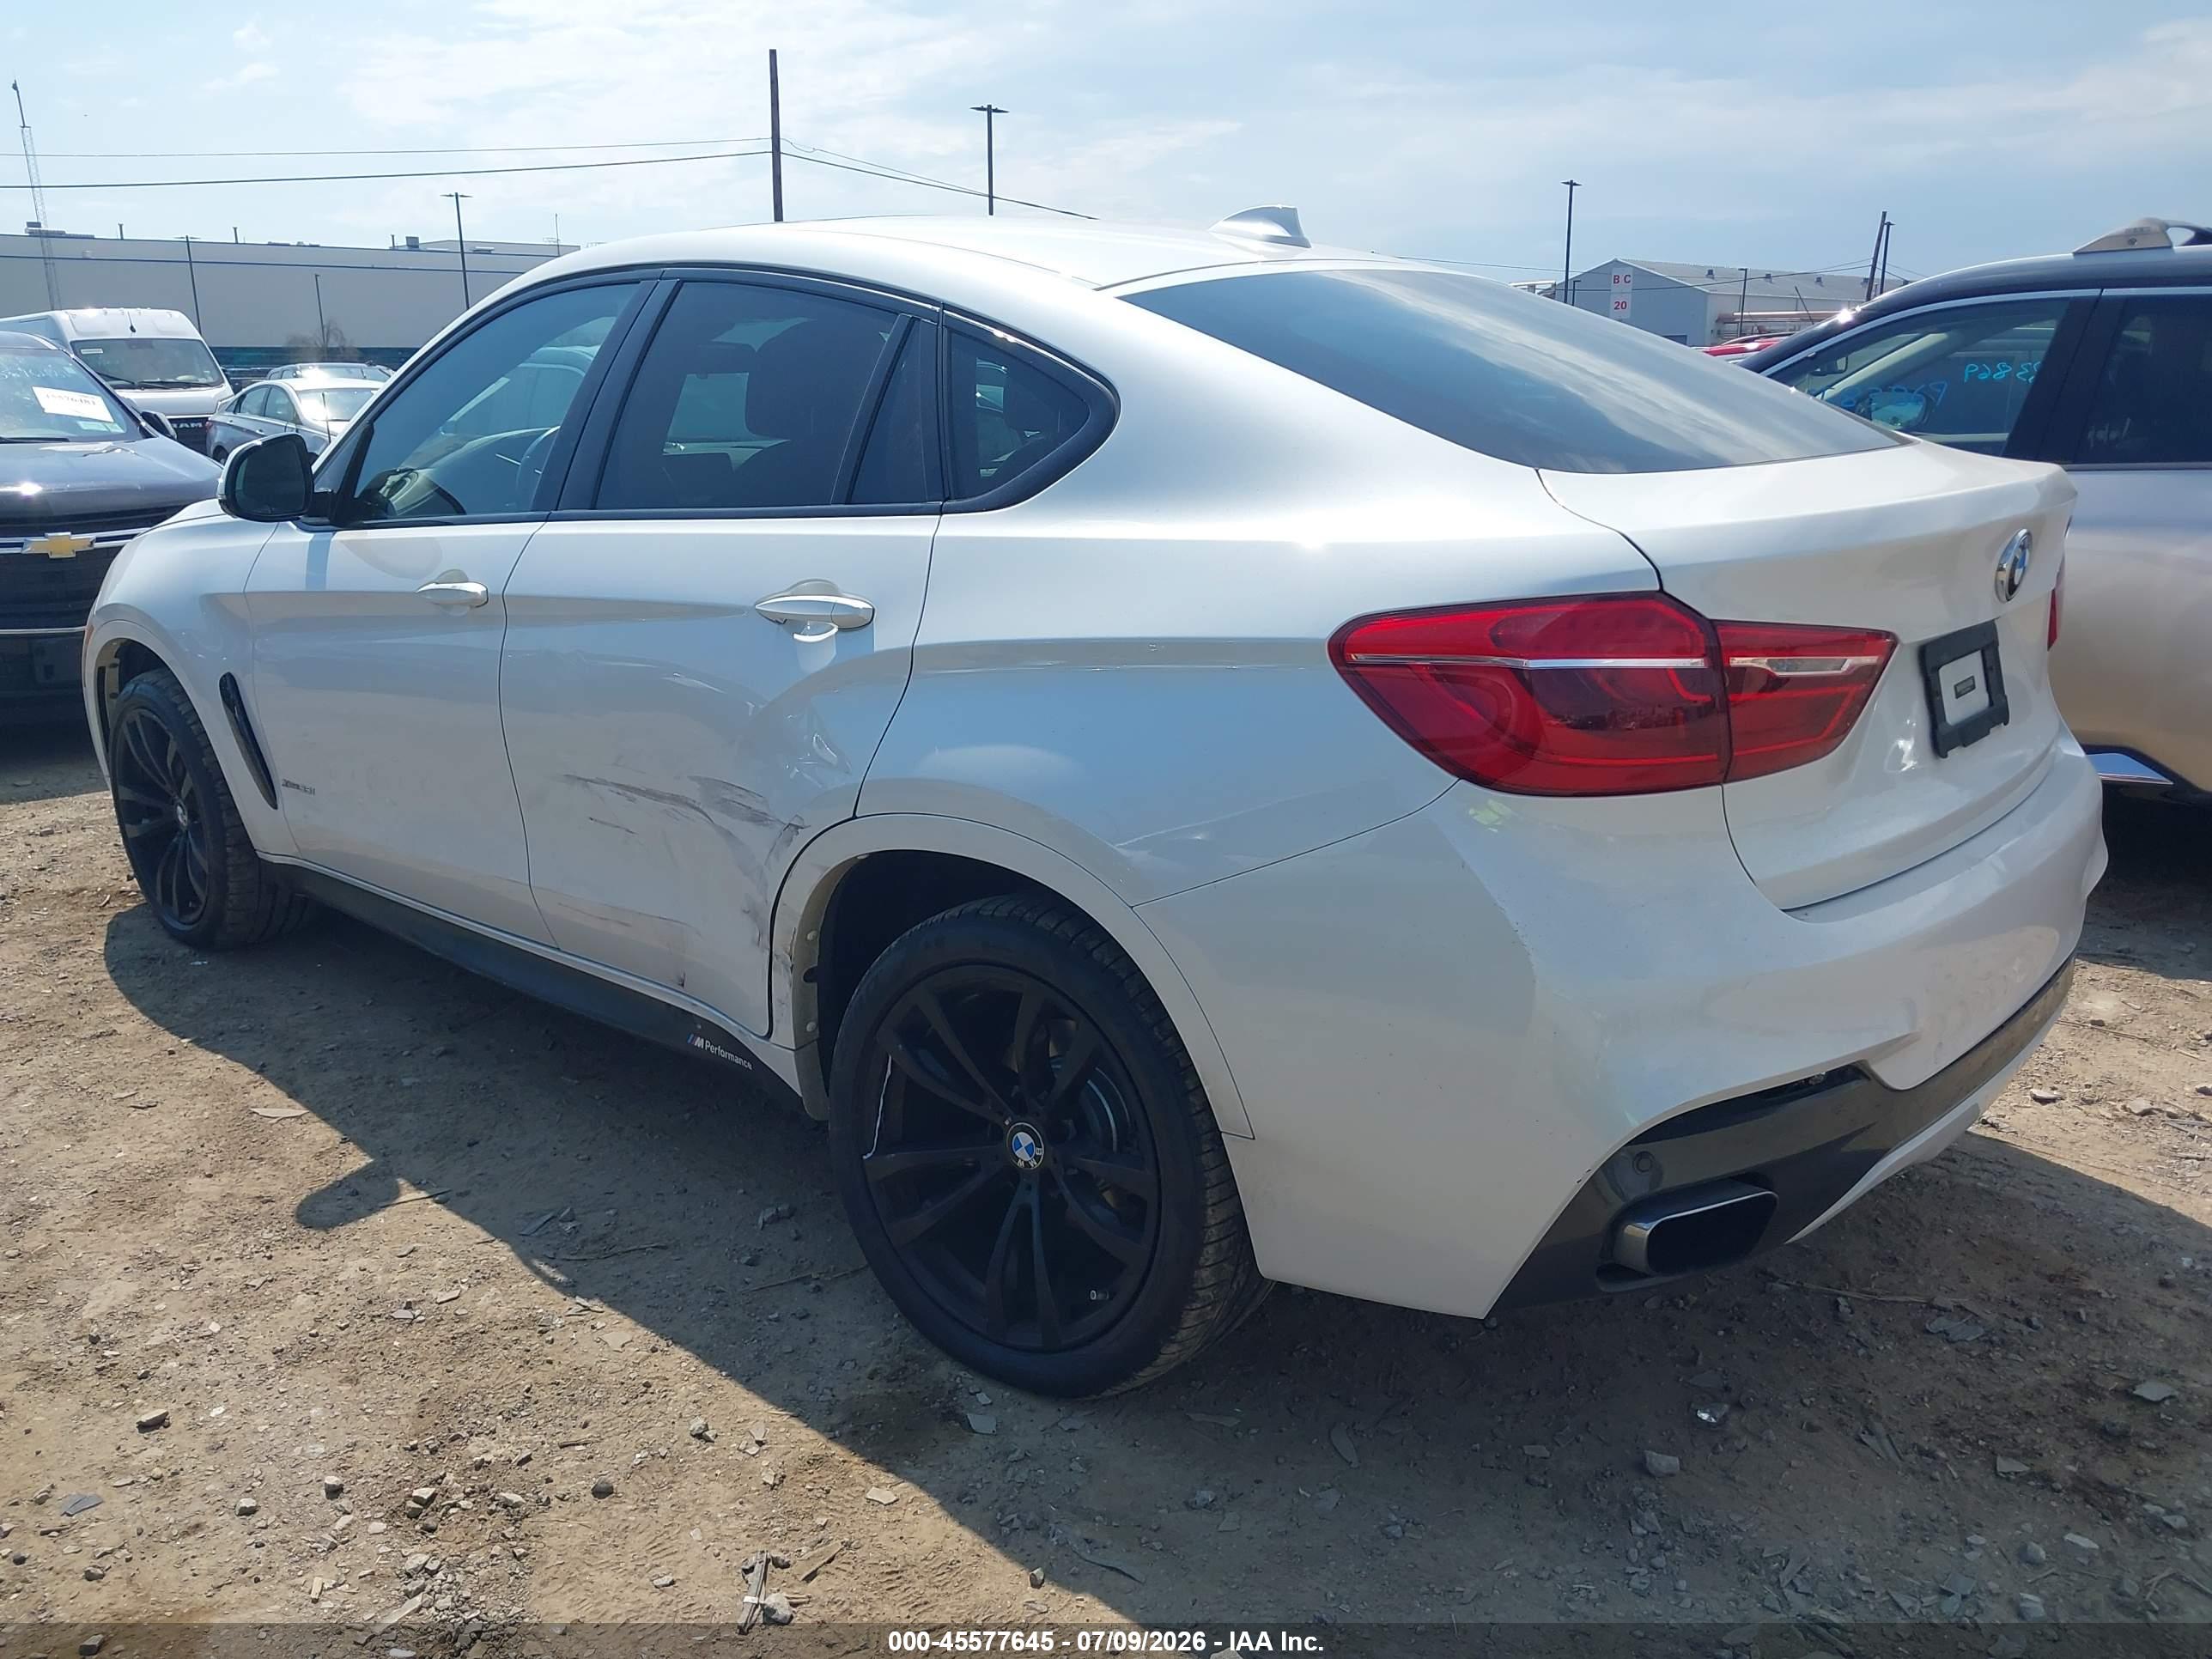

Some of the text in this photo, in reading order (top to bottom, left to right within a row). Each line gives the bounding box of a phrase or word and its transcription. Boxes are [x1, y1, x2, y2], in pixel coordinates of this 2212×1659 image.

[1613, 274, 1632, 284] B C
[1613, 301, 1627, 310] 20
[704, 1040, 753, 1071] Performance
